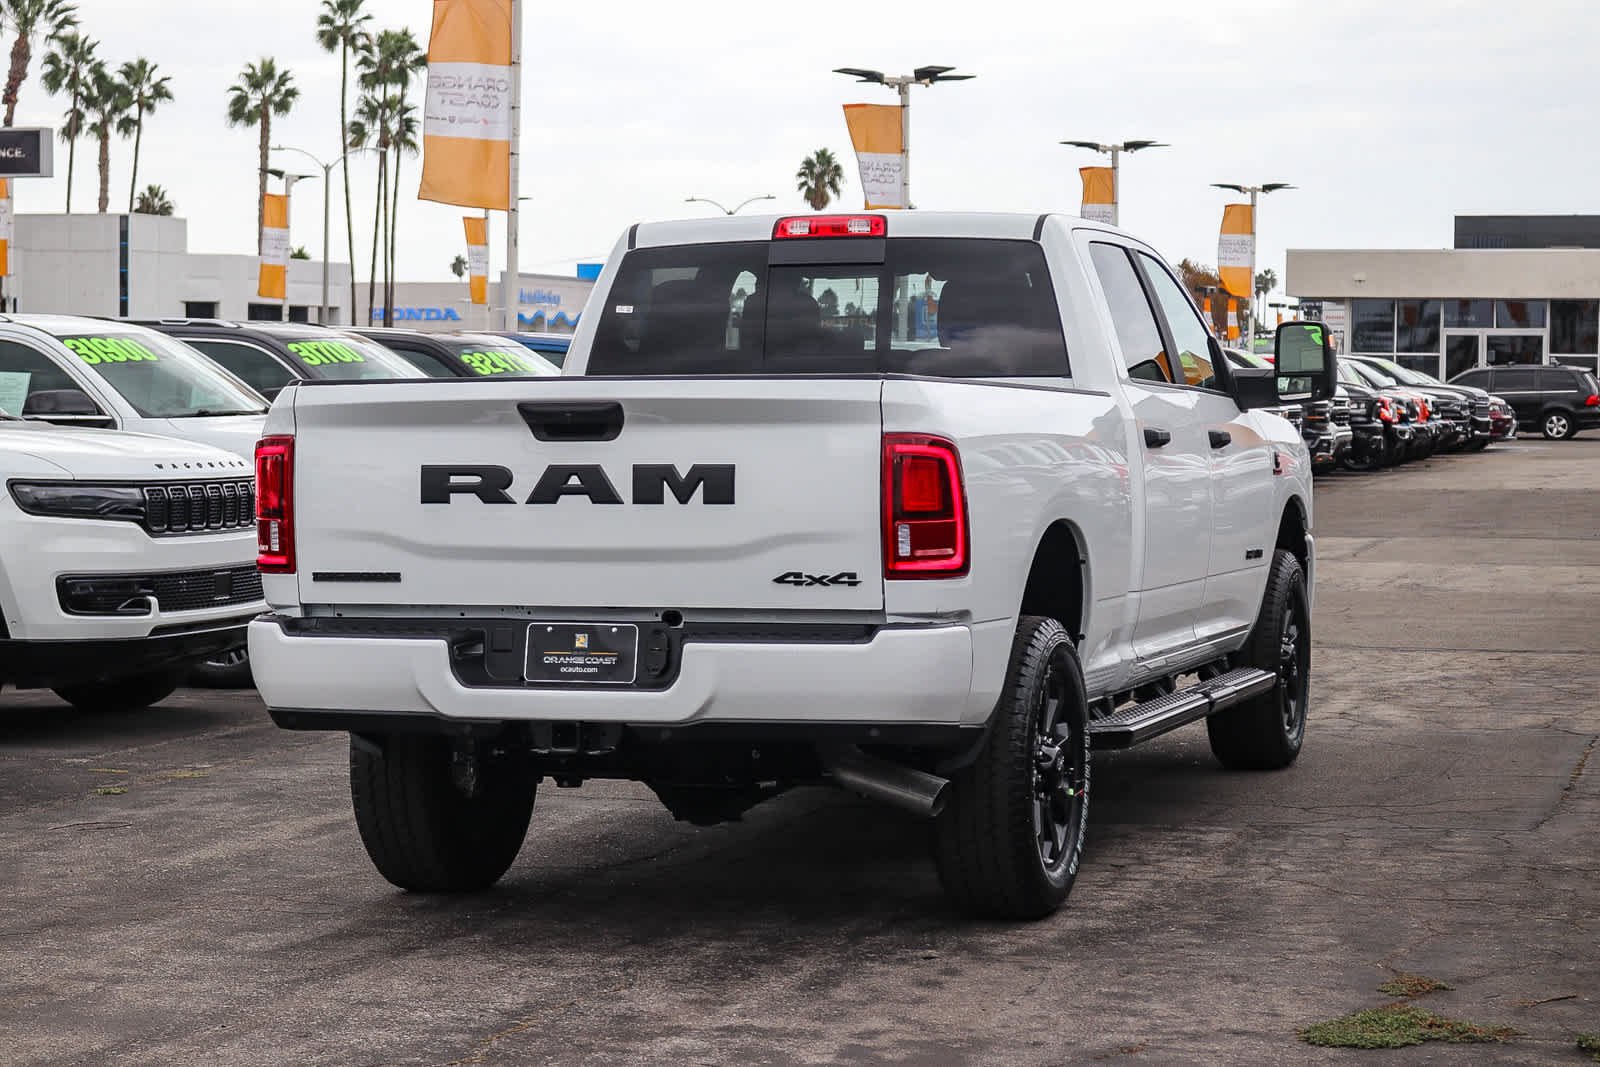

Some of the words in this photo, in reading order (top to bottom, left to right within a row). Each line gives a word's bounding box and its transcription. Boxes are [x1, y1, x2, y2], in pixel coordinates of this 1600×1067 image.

[63, 337, 159, 365] 31900
[420, 464, 736, 505] RAM
[772, 571, 863, 587] 4x4
[543, 655, 584, 664] ORANGE
[585, 656, 618, 665] COAST
